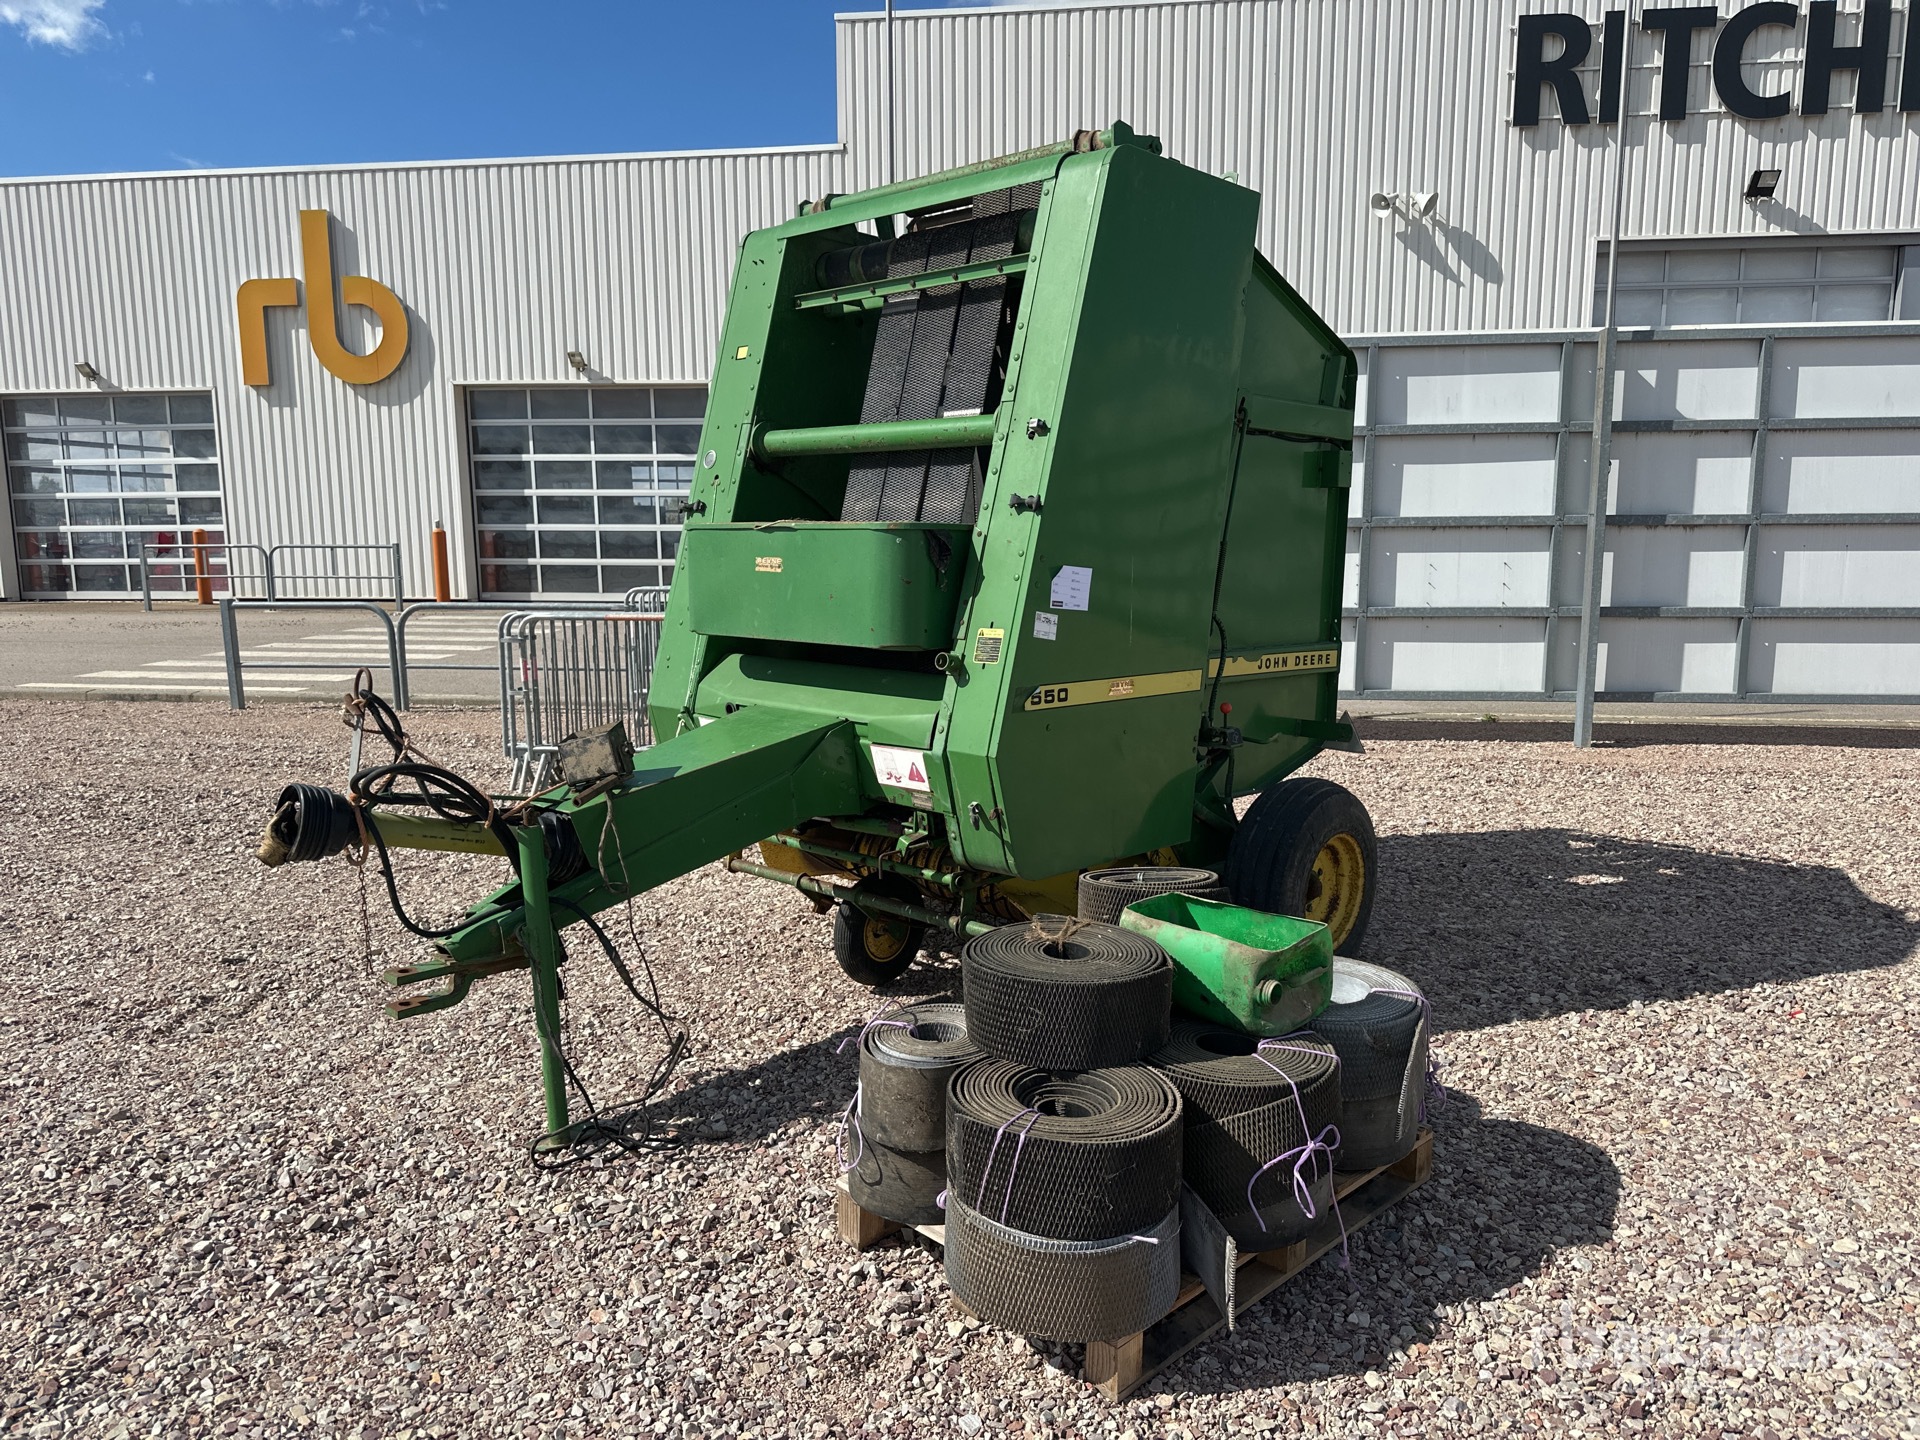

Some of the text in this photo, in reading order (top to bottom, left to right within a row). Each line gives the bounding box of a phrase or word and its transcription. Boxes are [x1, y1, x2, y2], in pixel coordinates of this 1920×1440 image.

[236, 209, 409, 386] rb
[1257, 653, 1331, 670] JOHN DEERE
[1030, 687, 1068, 706] 550
